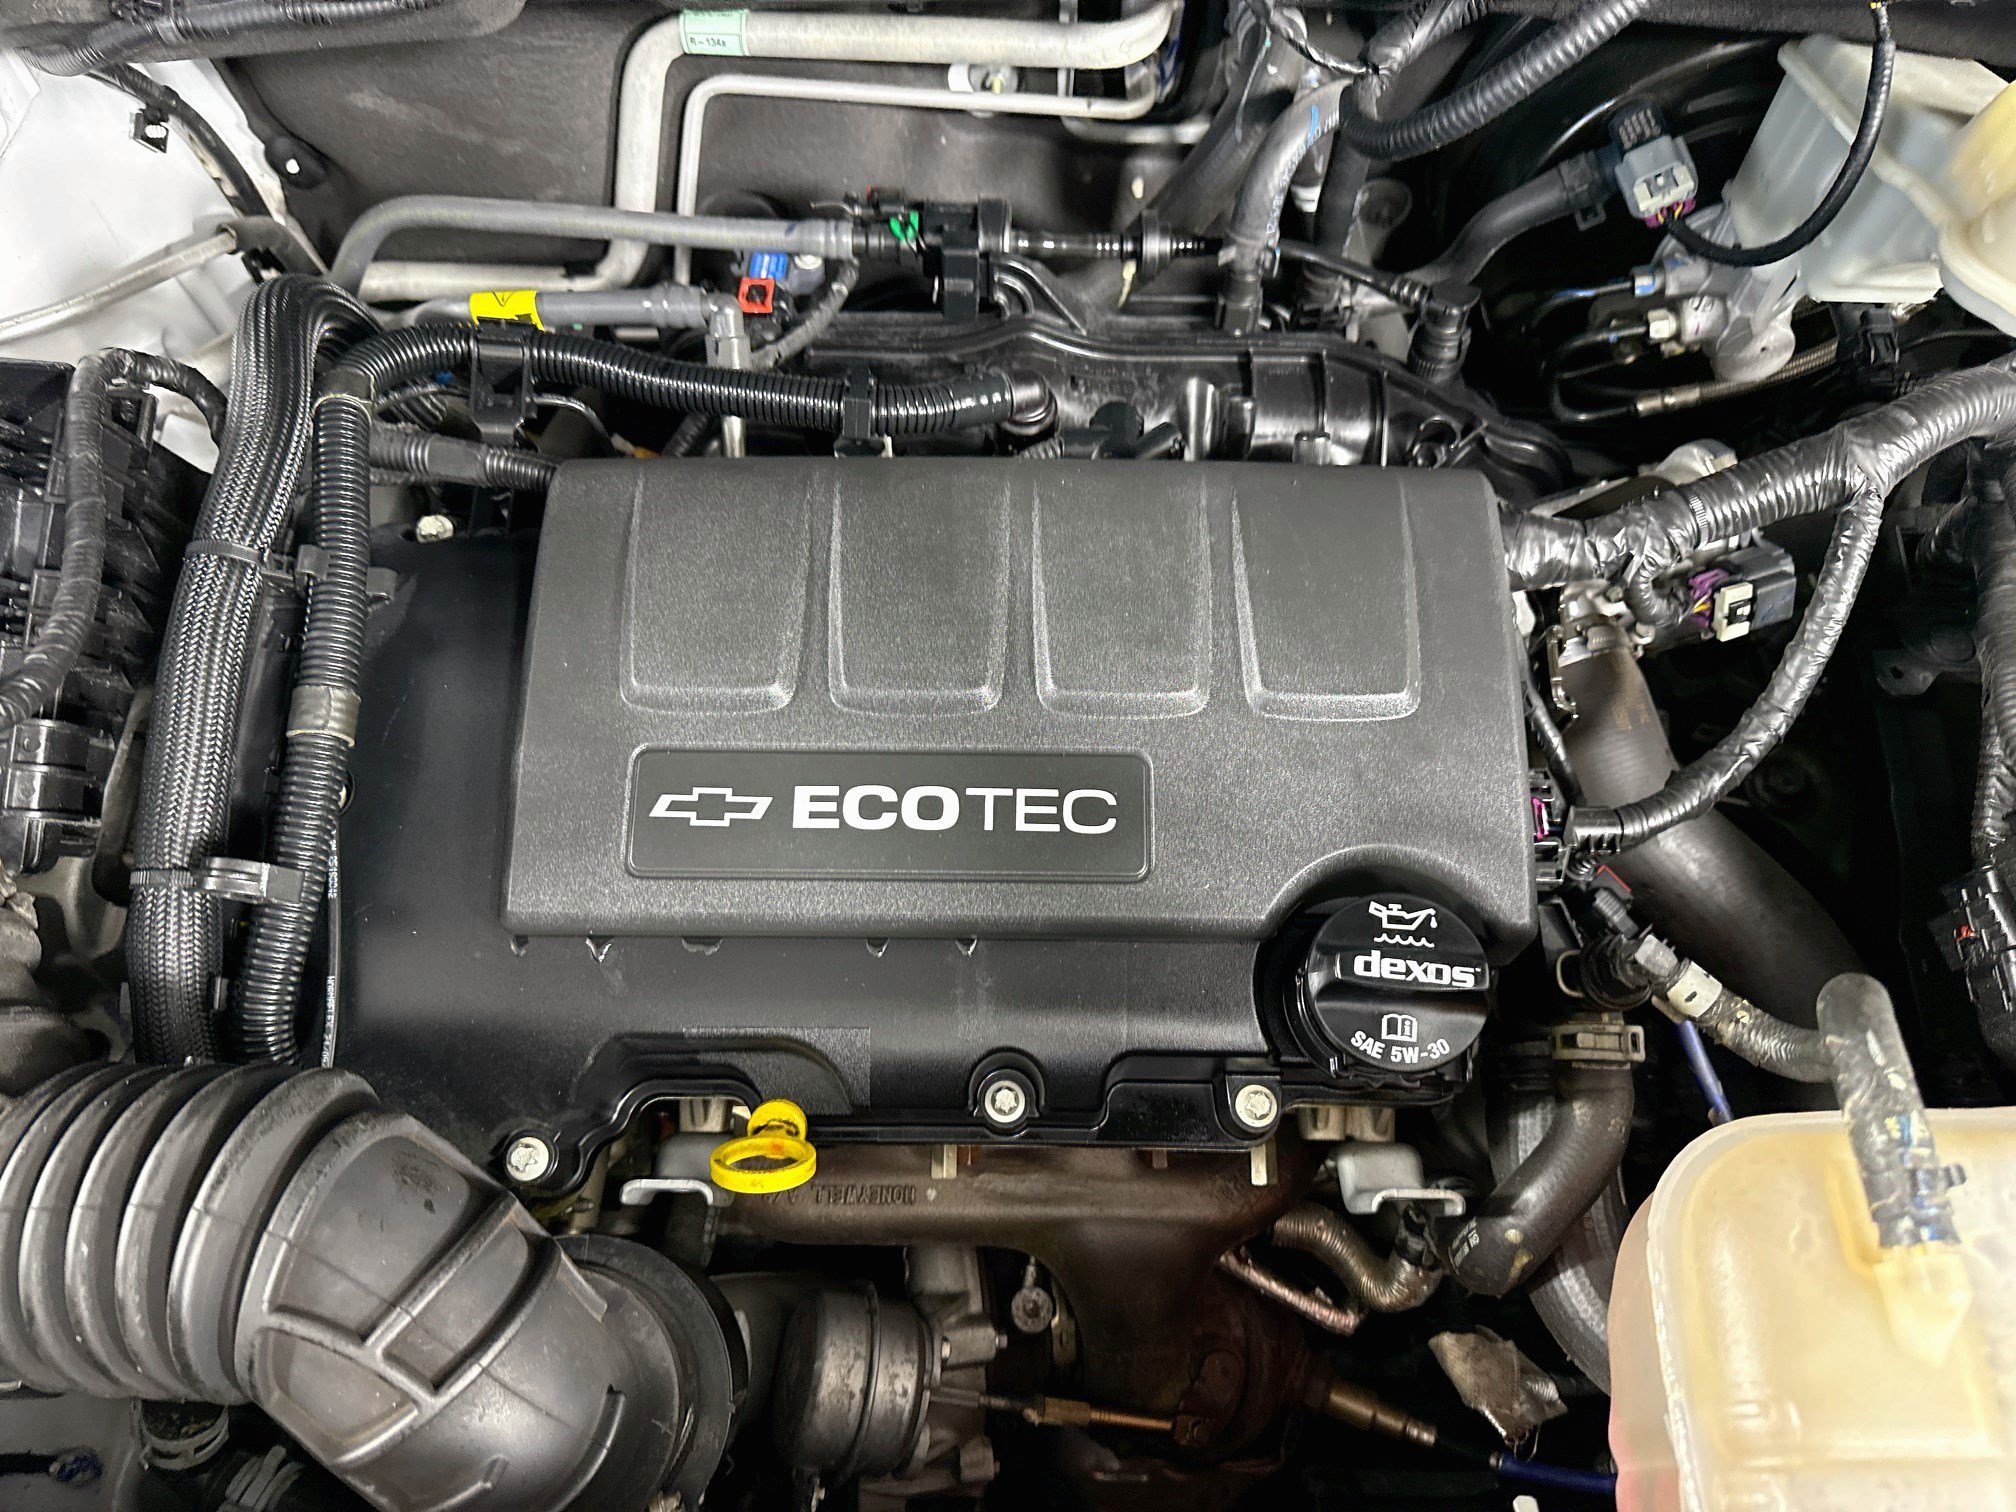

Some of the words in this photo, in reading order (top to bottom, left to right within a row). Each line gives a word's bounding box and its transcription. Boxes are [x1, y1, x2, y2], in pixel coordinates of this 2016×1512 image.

[792, 784, 1118, 835] ECOTEC
[1353, 949, 1476, 988] dexos
[1350, 1030, 1386, 1060] SAE
[1390, 1037, 1451, 1064] 5W-30
